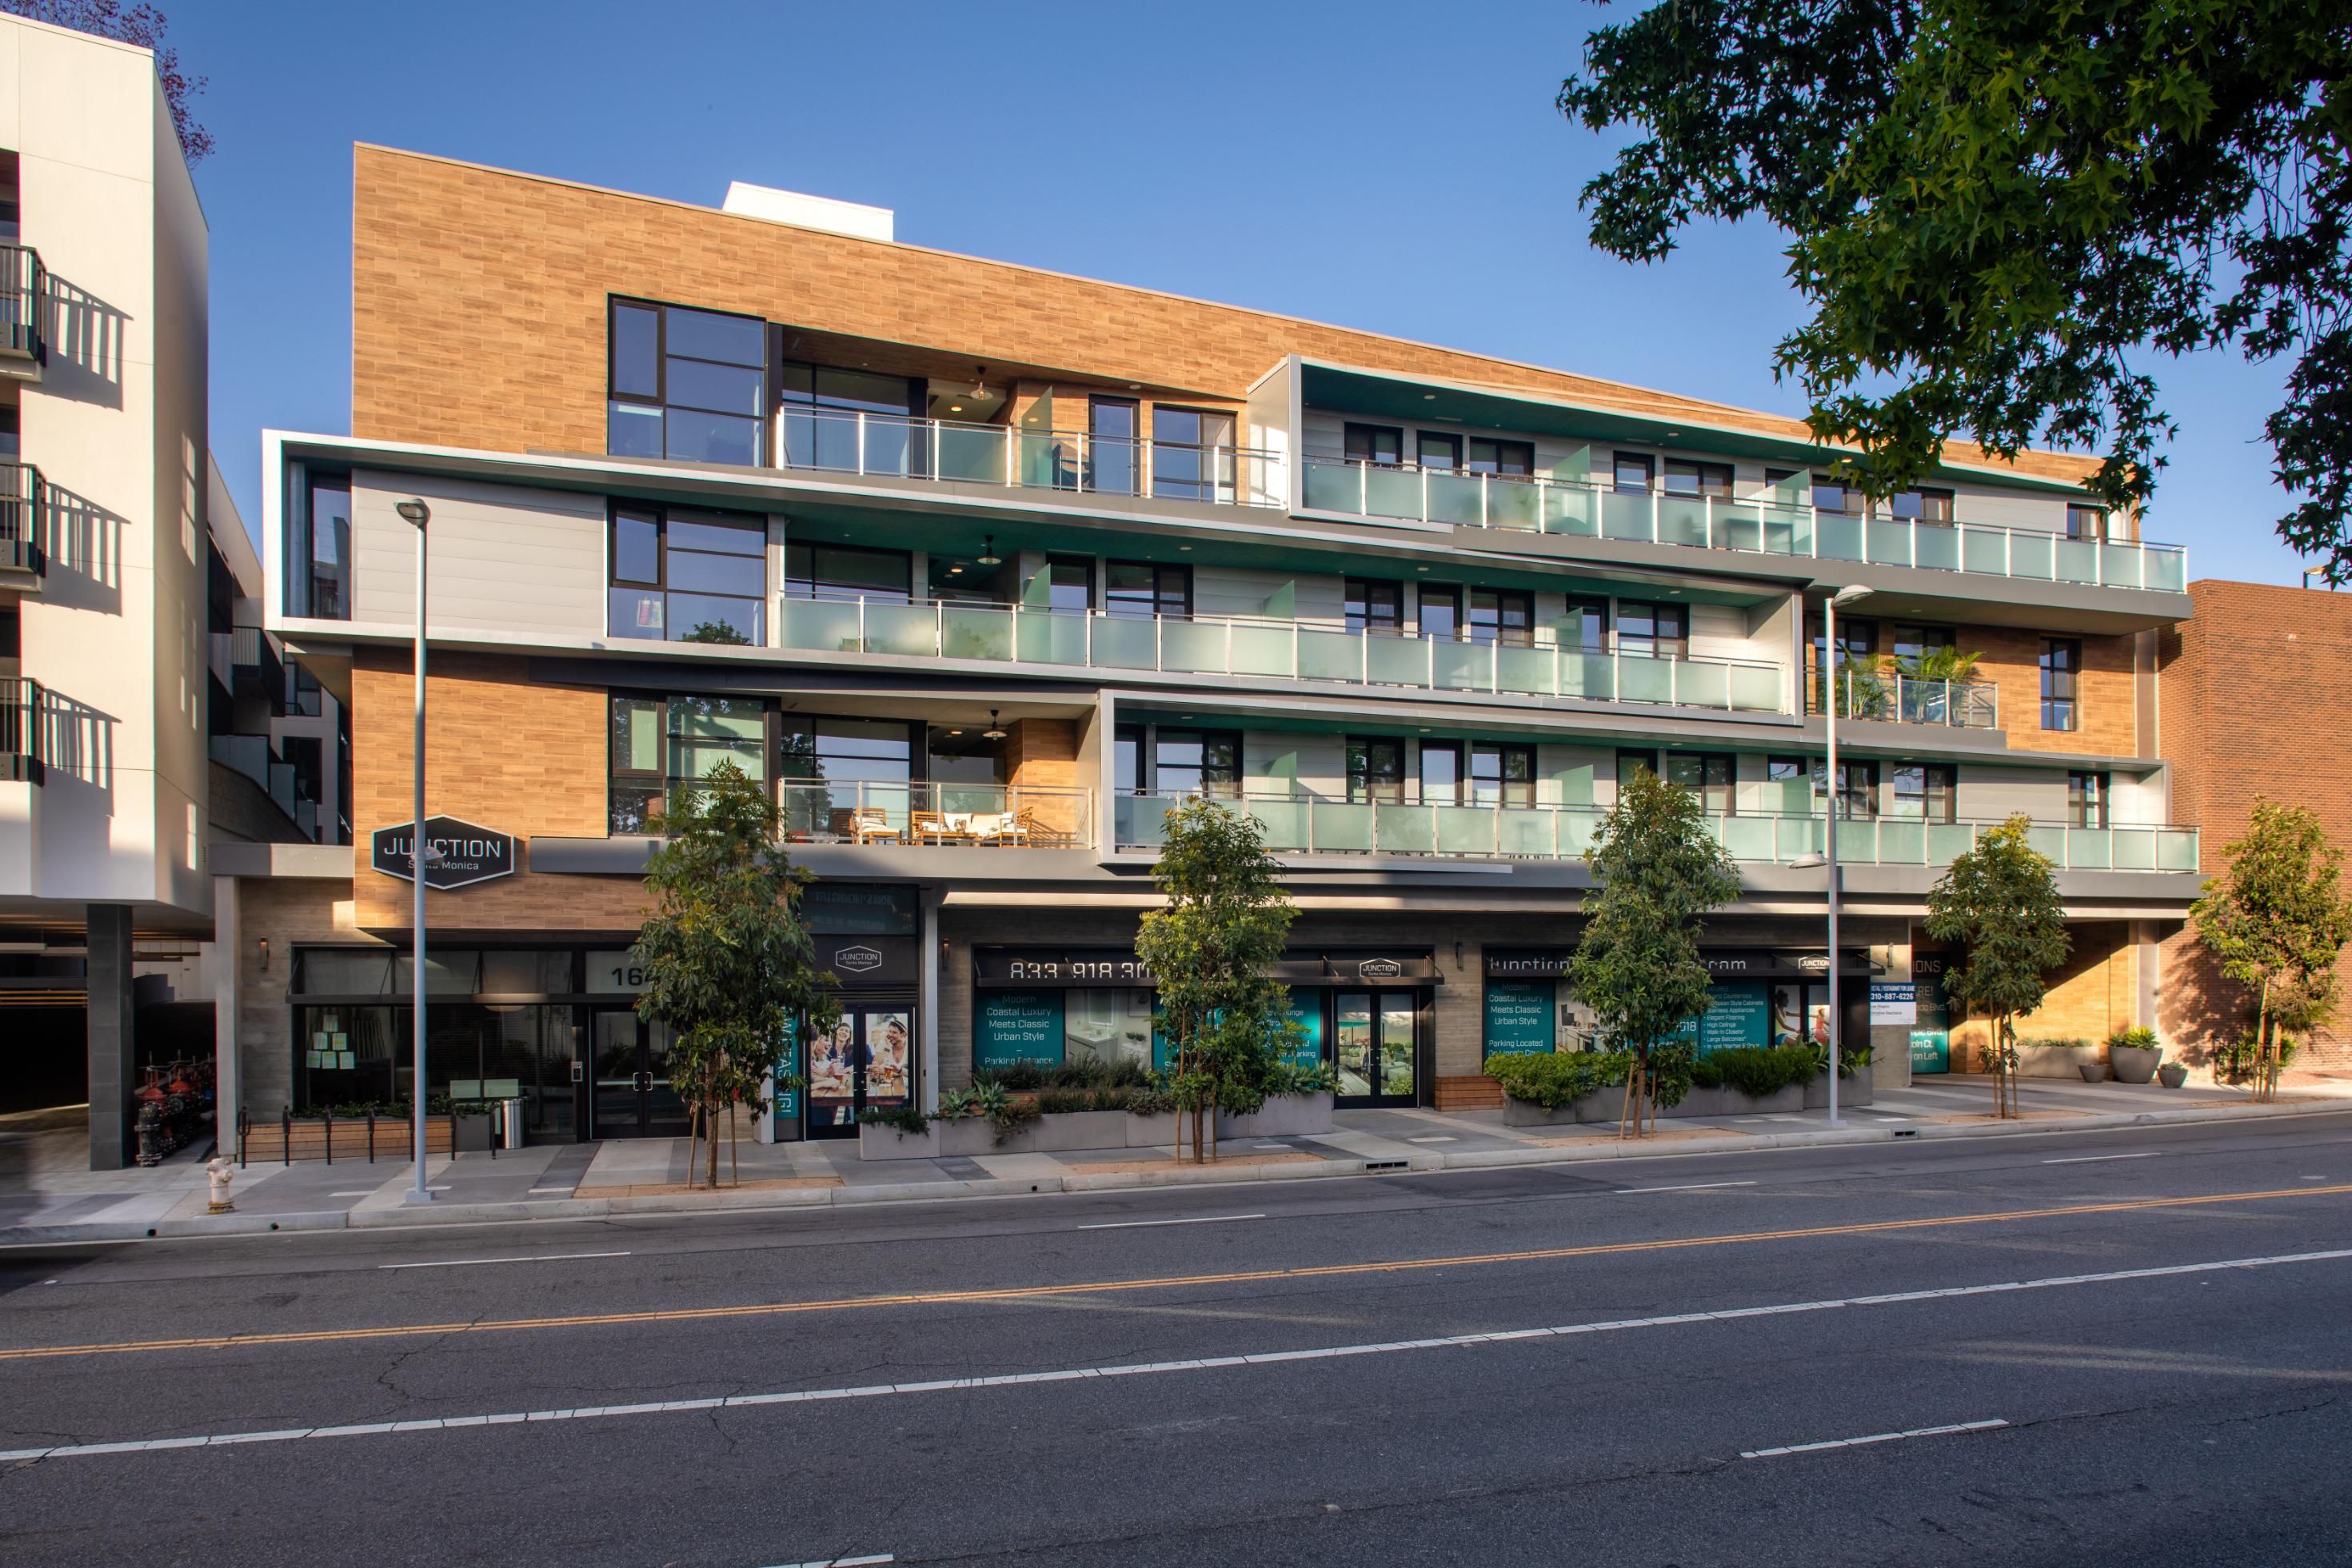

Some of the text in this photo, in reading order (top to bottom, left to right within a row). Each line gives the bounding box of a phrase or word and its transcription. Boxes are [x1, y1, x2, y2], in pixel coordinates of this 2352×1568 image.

[384, 837, 501, 858] JUCTION
[441, 860, 479, 870] Monica
[1488, 994, 1543, 1003] Coastal Luxury
[987, 1007, 1052, 1017] Coastal Luxury
[1515, 1005, 1542, 1014] Classic
[989, 1019, 1050, 1028] Meets Classic
[1494, 1016, 1538, 1026] Urban Style
[994, 1032, 1044, 1042] Urban Style
[1923, 1051, 1939, 1060] Left
[984, 1057, 1016, 1066] Parking
